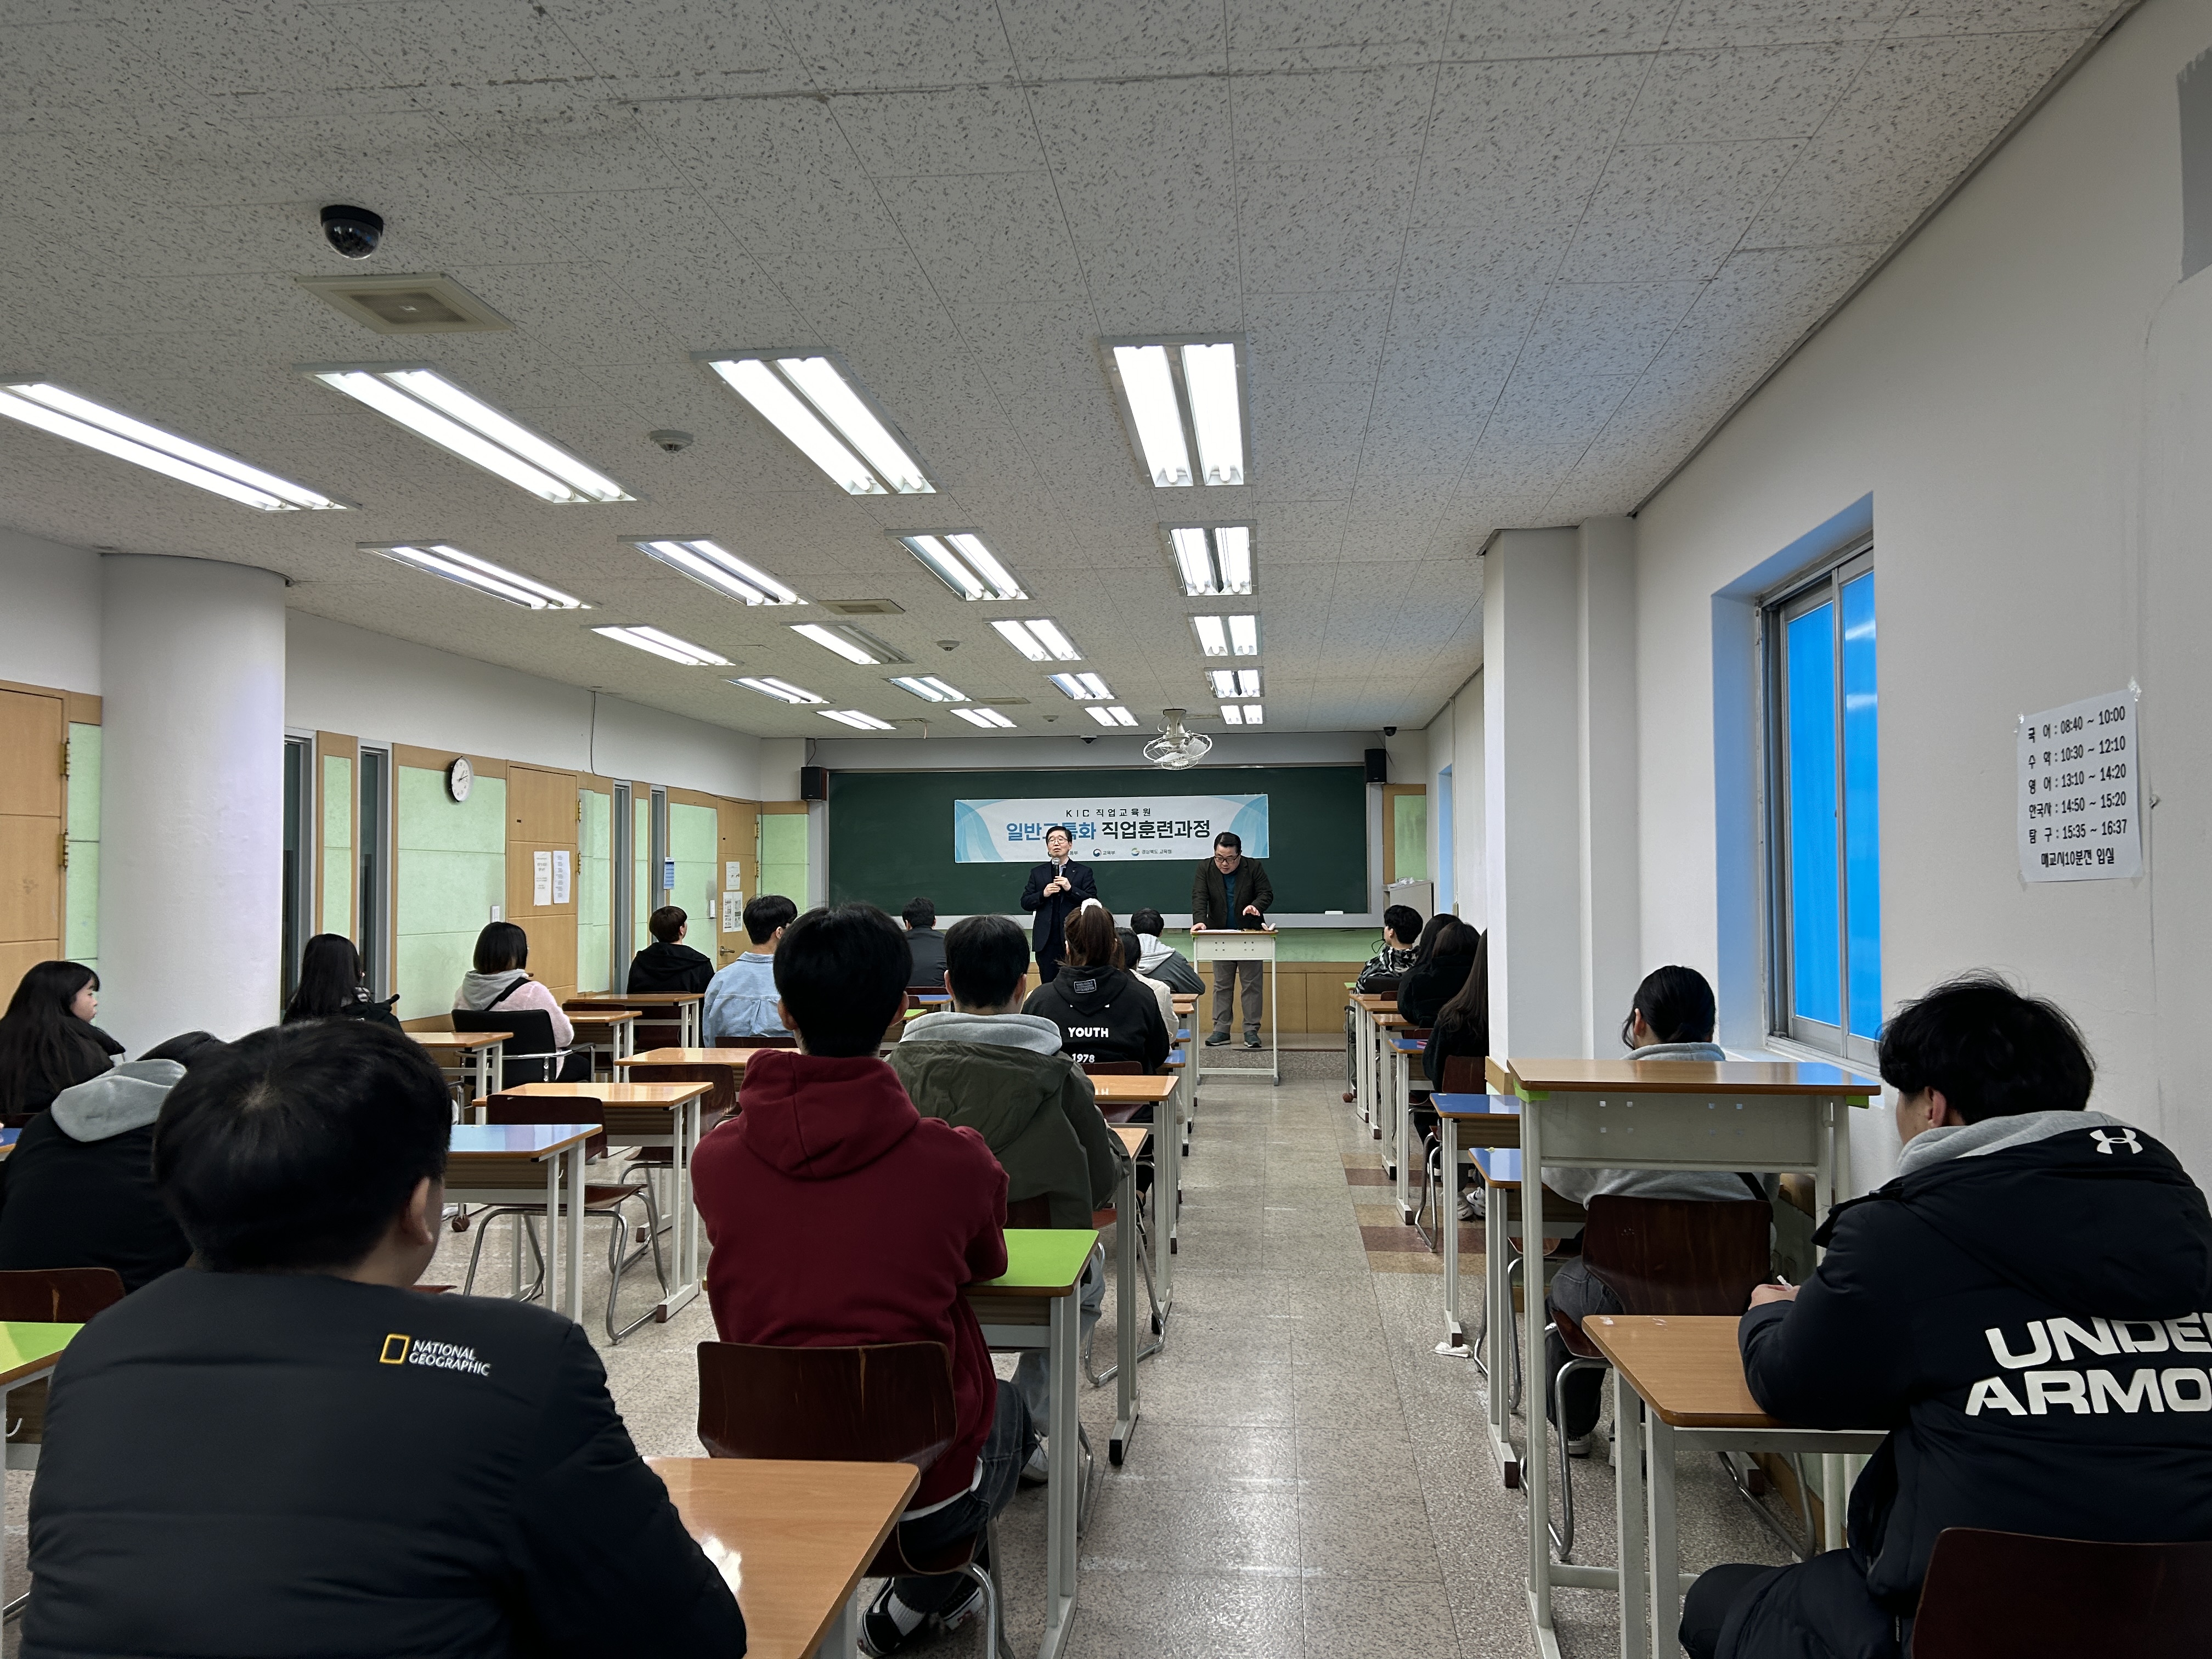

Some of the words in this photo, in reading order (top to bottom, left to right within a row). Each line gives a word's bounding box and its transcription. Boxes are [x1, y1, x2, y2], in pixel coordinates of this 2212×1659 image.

[2042, 724, 2051, 739] 어
[2061, 716, 2083, 734] 08:40
[2099, 706, 2125, 725] 10:00
[2028, 755, 2036, 769] 수
[2061, 744, 2084, 762] 10:30
[2099, 735, 2126, 754] 12:10
[2028, 779, 2036, 794] 영
[2044, 776, 2051, 791] 어
[2061, 770, 2084, 787] 13:10
[2100, 763, 2126, 781] 14:20
[1096, 808, 1151, 817] 직업교육원
[2062, 797, 2085, 814] 14:50
[2101, 791, 2126, 808] 15:20
[1101, 820, 1210, 839] 직업훈련과정
[2044, 827, 2052, 842] 구
[2063, 823, 2086, 839] 15:35
[2102, 819, 2127, 836] 16:37
[2096, 848, 2114, 865] 입실
[1068, 1027, 1109, 1038] YOUTH
[1072, 1053, 1095, 1063] 1978
[413, 1340, 476, 1361] NATIONAL
[1985, 1312, 2212, 1369] UNDE
[409, 1352, 492, 1376] GEOGRAPHIC
[1965, 1368, 2212, 1416] ARMO
